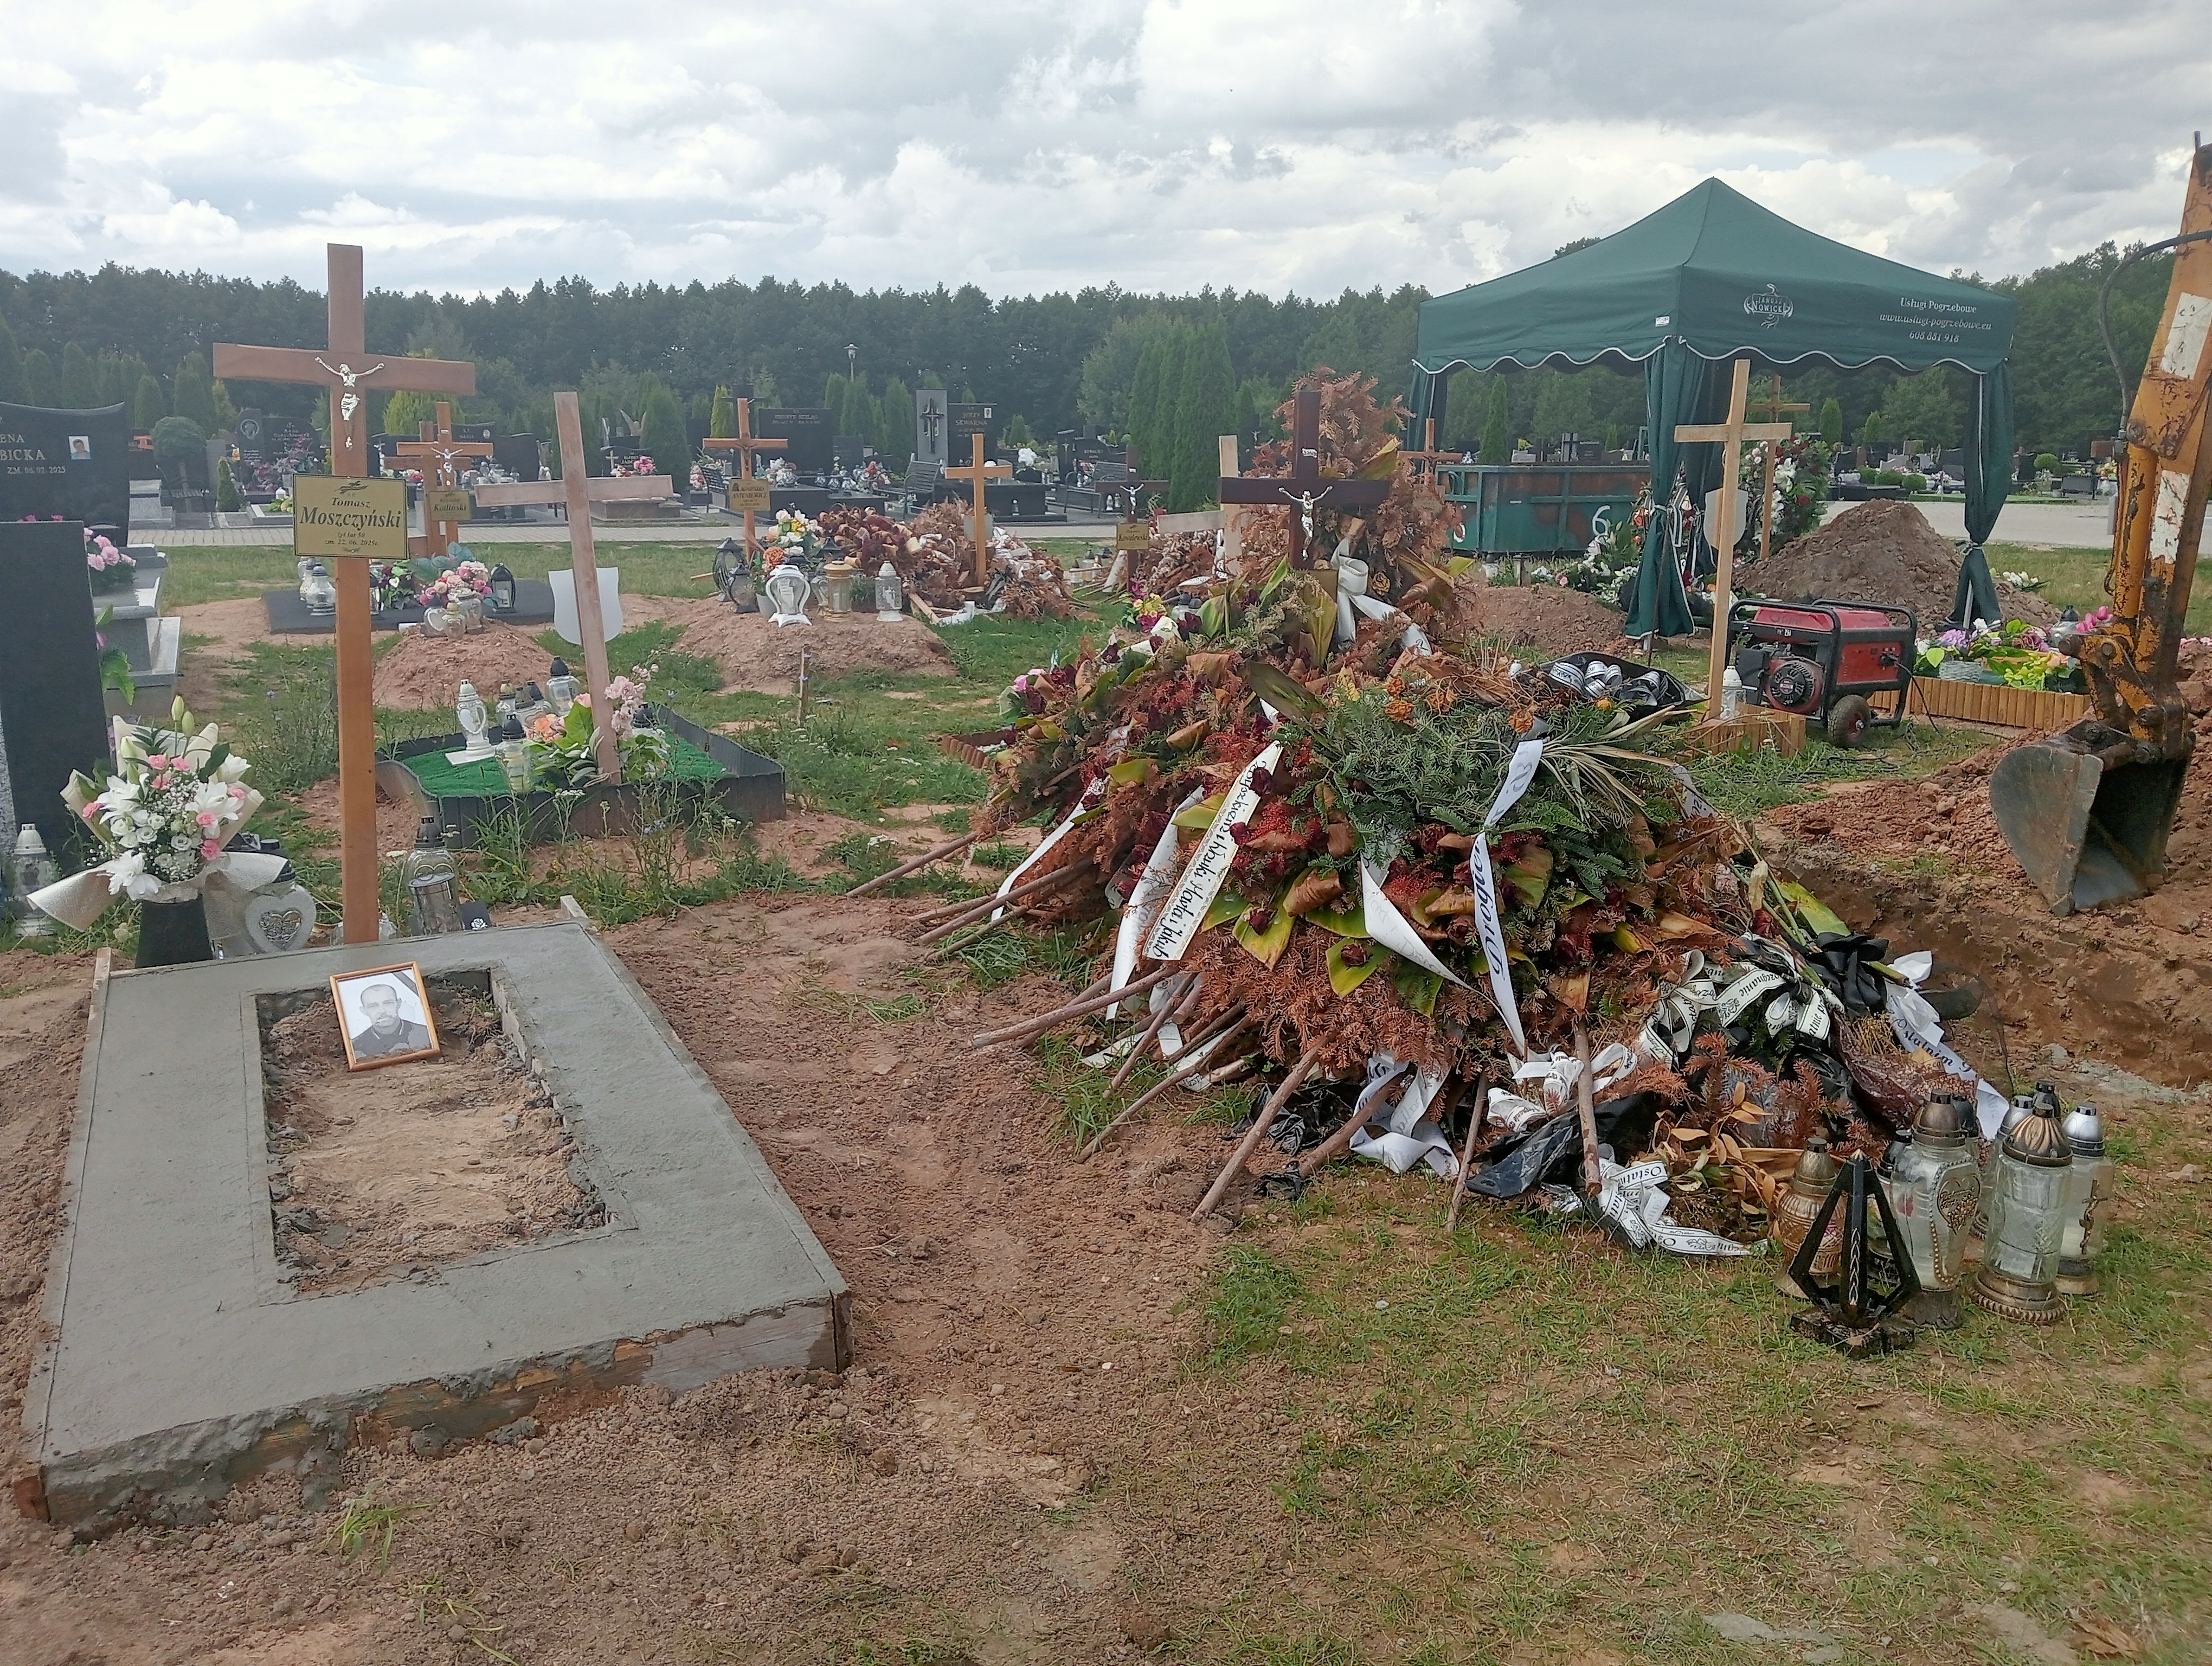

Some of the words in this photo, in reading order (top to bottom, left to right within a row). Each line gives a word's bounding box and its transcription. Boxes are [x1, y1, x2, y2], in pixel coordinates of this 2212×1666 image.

[1752, 300, 1786, 316] NOWICKI
[1758, 296, 1782, 305] JANUSZ
[1900, 297, 1927, 310] Usługi
[1928, 300, 1977, 313] Pogrzebowe
[1909, 331, 1925, 339] 608
[1926, 332, 1941, 342] 881
[1944, 333, 1960, 343] 918
[332, 497, 371, 509] Tomasz
[299, 506, 401, 531] Moszczyński
[1592, 504, 1611, 537] 6
[1153, 917, 1183, 959] Jakub
